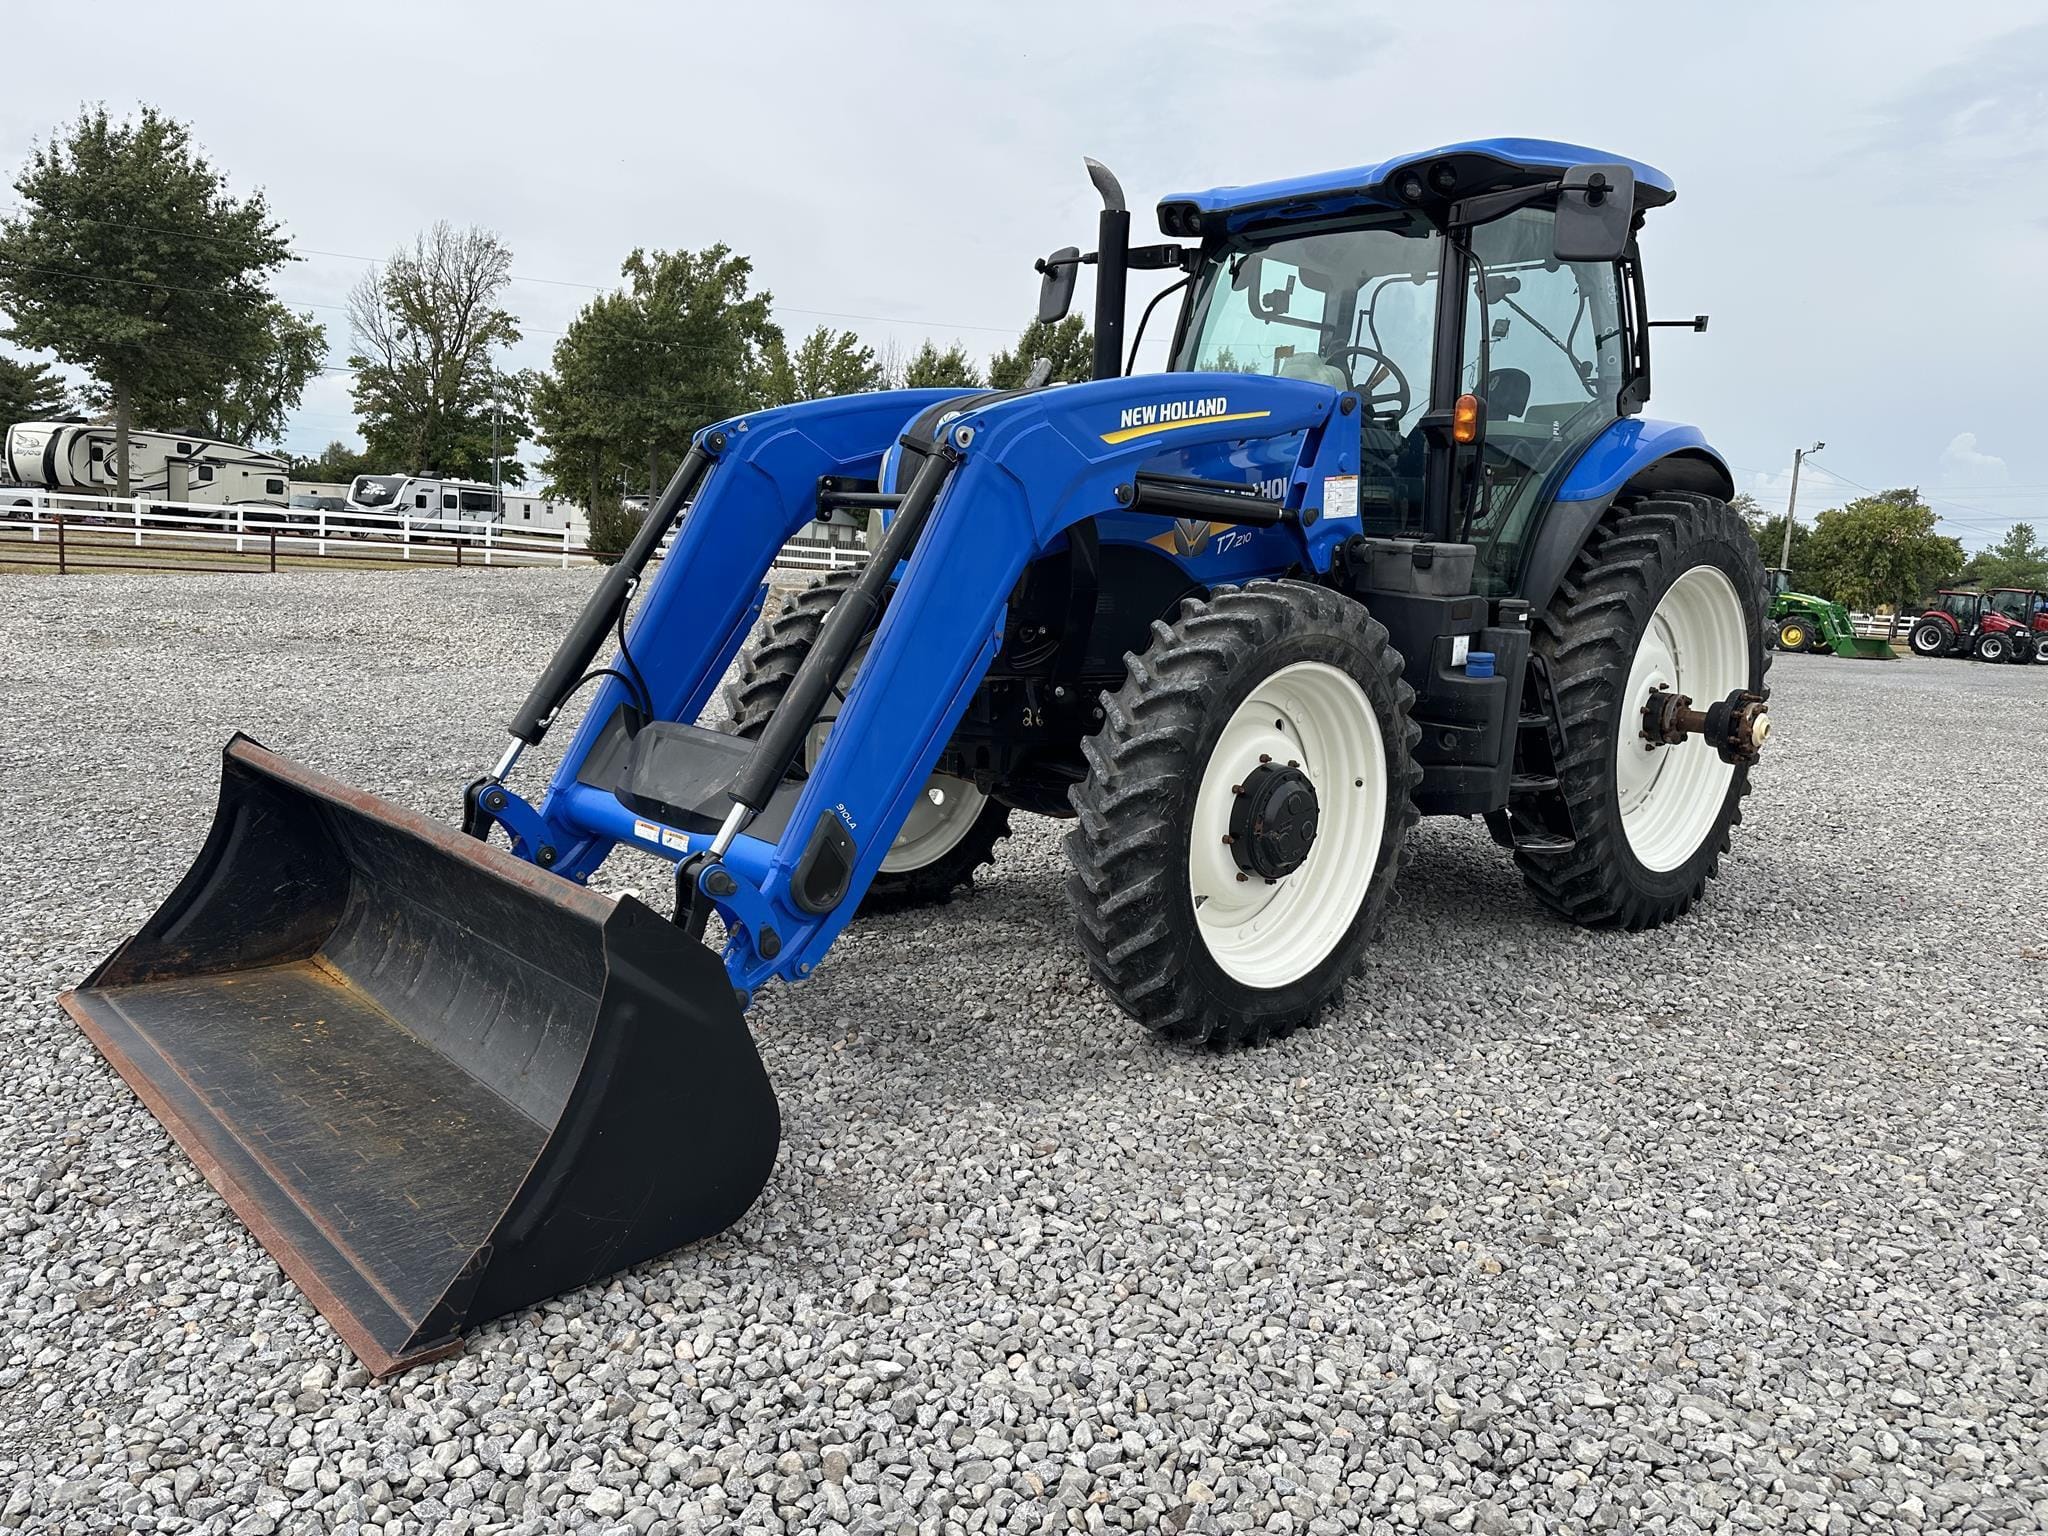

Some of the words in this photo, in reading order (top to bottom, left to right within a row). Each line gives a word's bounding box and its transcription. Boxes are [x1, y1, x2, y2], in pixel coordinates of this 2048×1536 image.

[1120, 405, 1157, 428] NEW
[1160, 397, 1227, 422] HOLLAND
[1023, 707, 1044, 727] 26
[836, 803, 857, 830] 910LA
